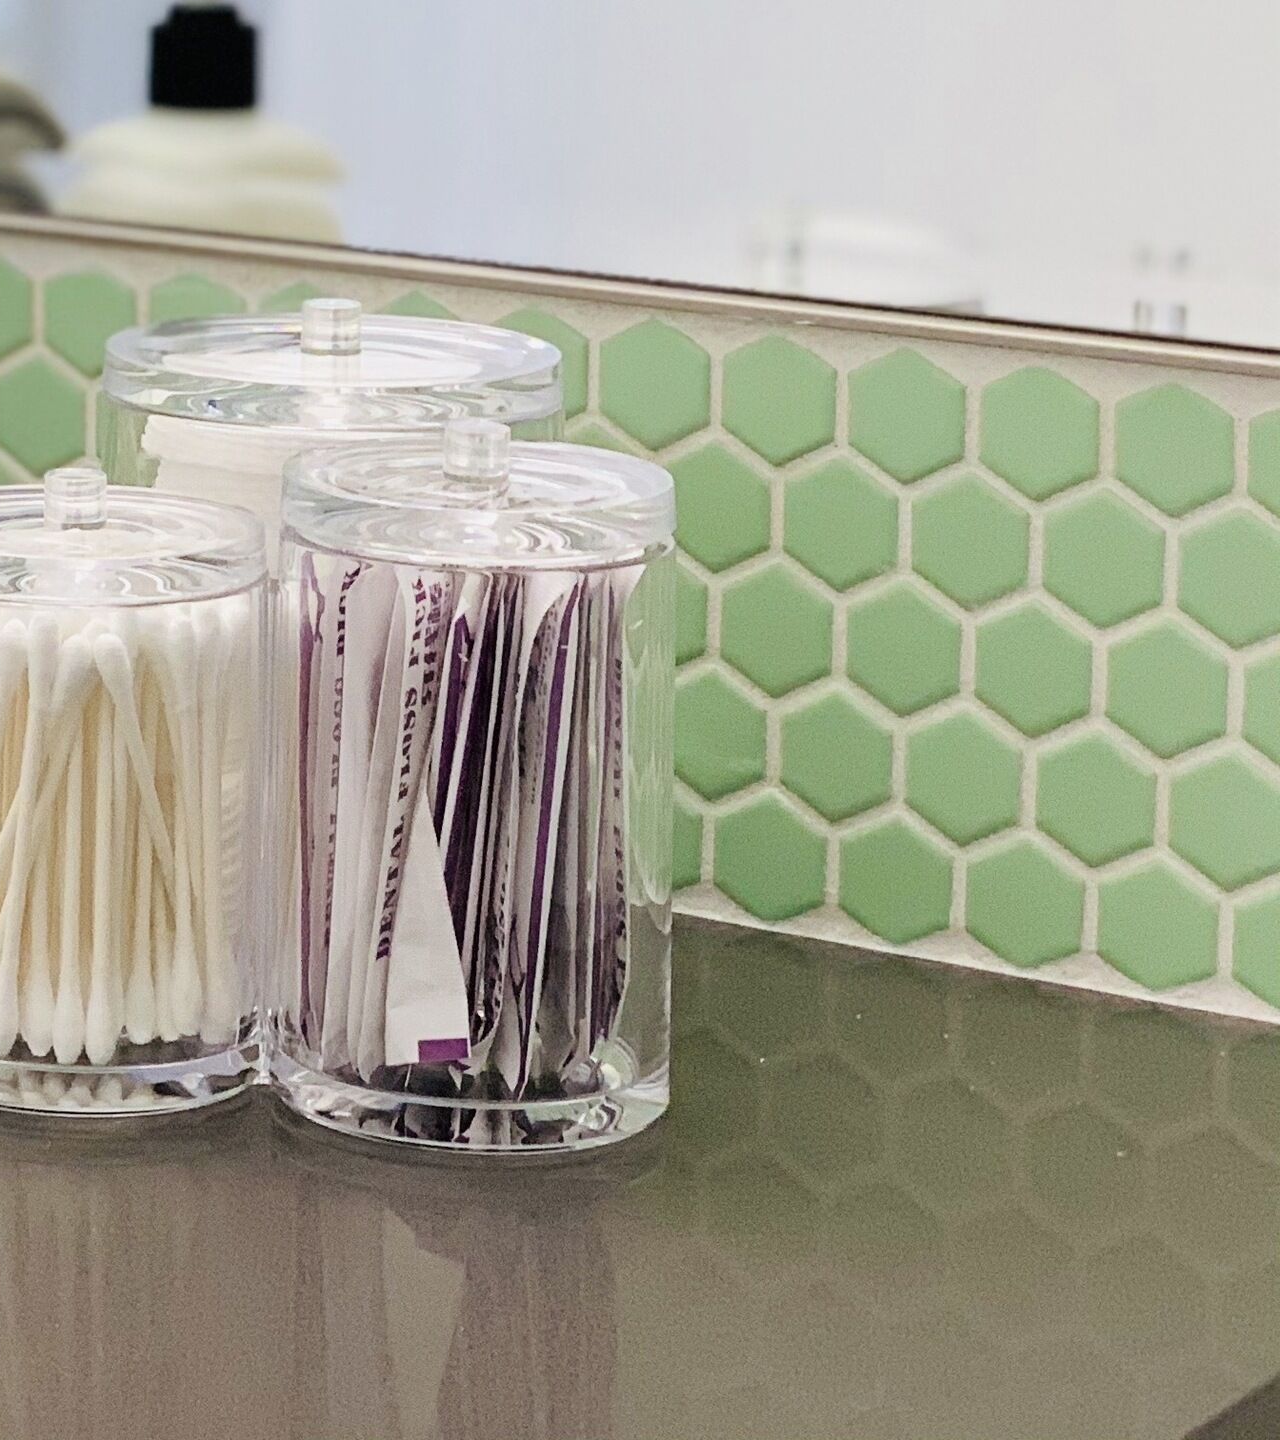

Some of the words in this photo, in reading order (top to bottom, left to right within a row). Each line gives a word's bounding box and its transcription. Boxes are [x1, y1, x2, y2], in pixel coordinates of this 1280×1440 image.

[407, 574, 429, 667] PICK
[398, 686, 419, 803] FLOSS
[374, 815, 407, 962] DENTAL
